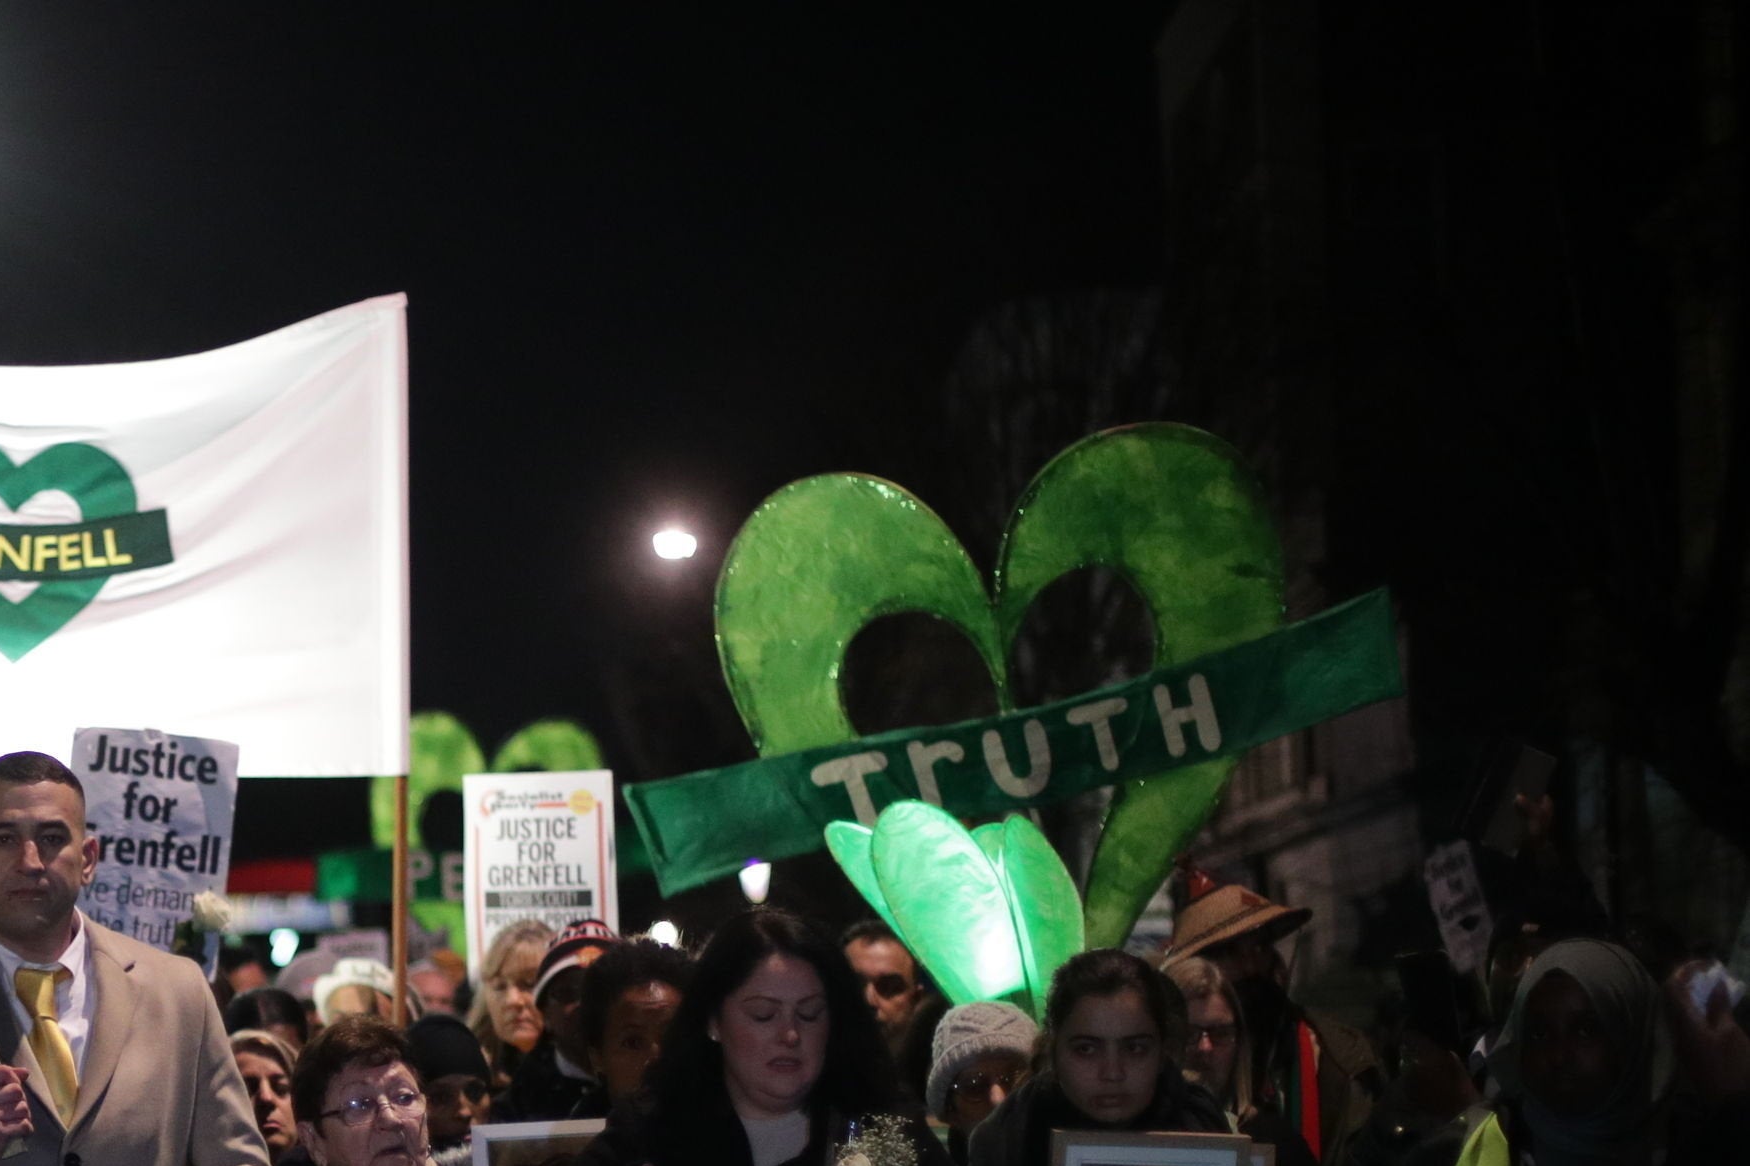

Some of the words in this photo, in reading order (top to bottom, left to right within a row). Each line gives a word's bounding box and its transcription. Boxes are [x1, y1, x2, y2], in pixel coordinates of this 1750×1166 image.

[89, 735, 218, 785] Justice
[123, 781, 177, 824] for
[497, 817, 578, 841] JUSTICE
[85, 822, 221, 875] renfell
[518, 842, 556, 863] FOR
[488, 864, 587, 887] GRENFELL
[116, 876, 195, 912] deman
